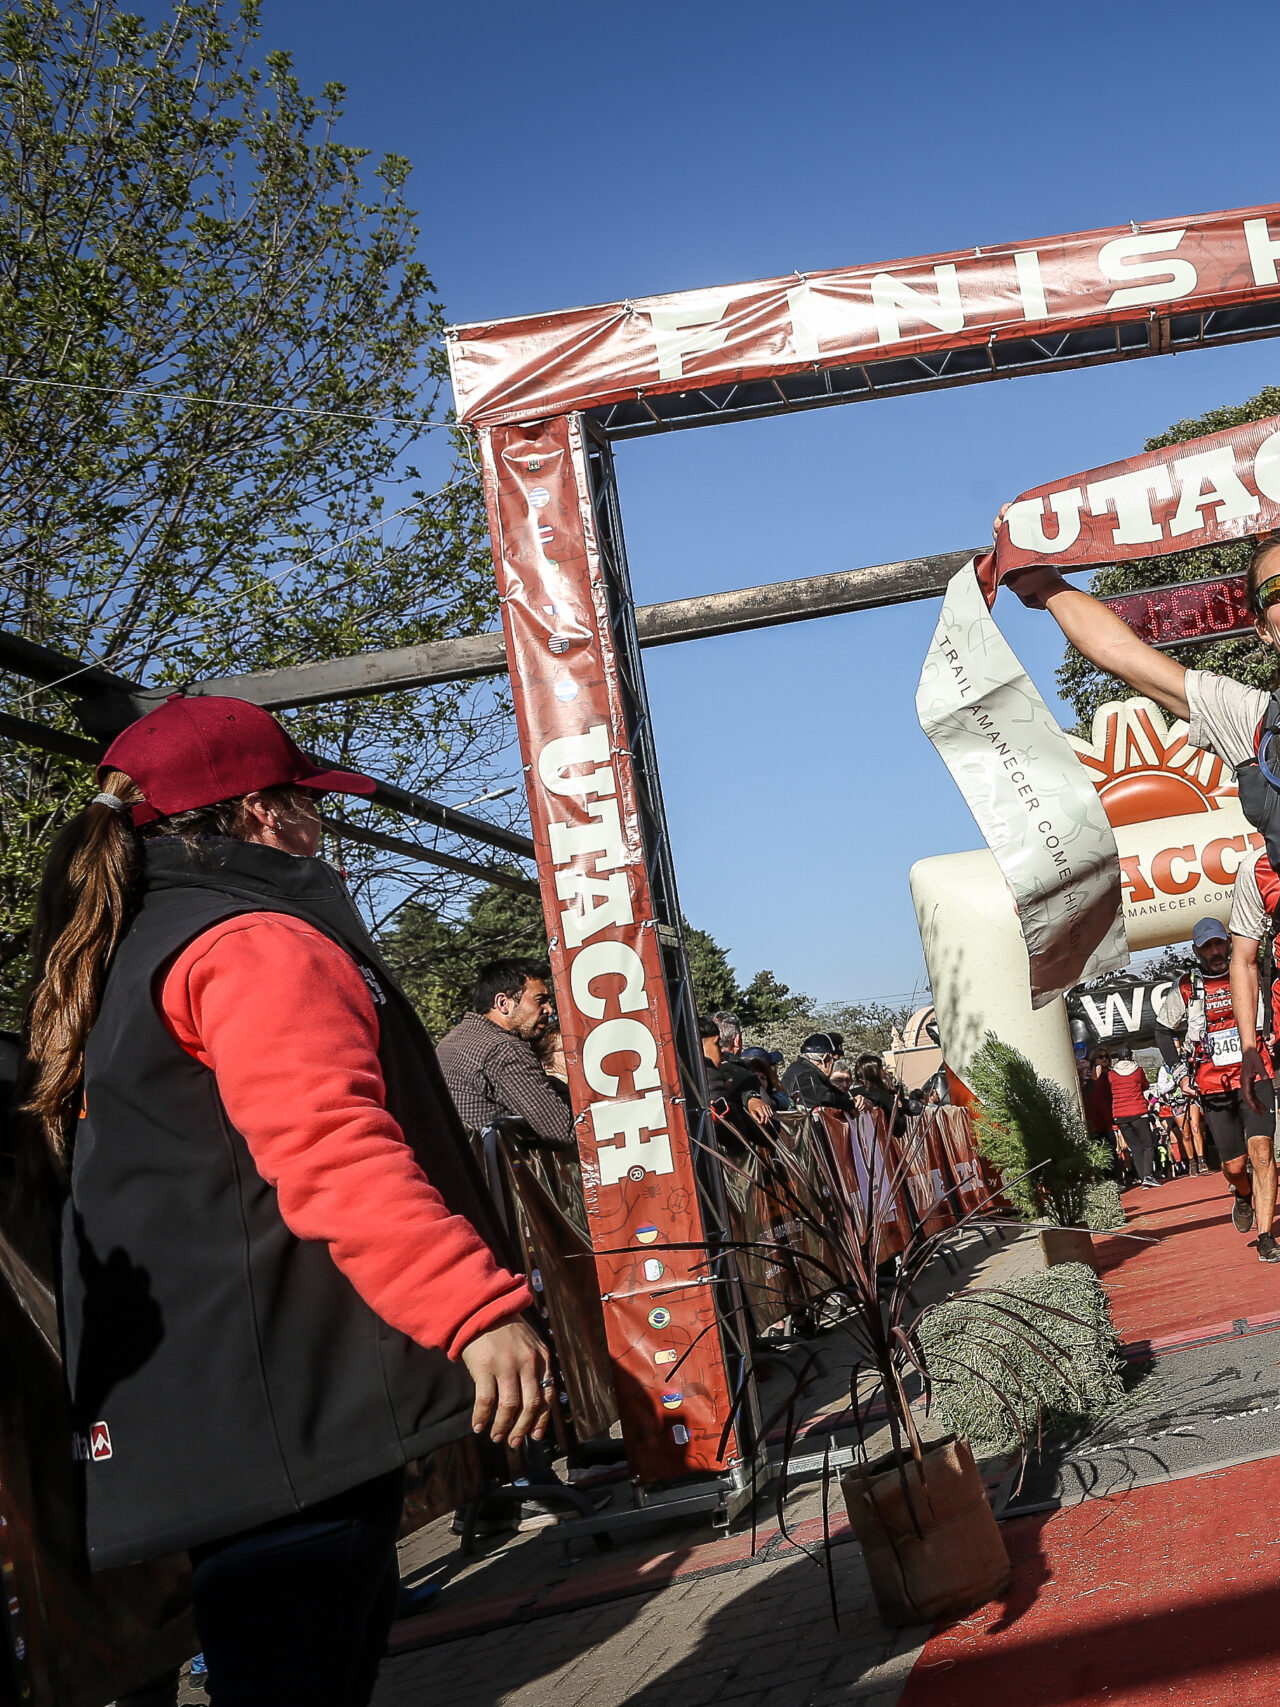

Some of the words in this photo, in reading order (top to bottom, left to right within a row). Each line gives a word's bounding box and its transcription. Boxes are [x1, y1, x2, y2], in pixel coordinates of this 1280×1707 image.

[938, 635, 975, 698] TRAIL
[968, 704, 1041, 812] AMANECER
[537, 723, 675, 1187] UTACCH
